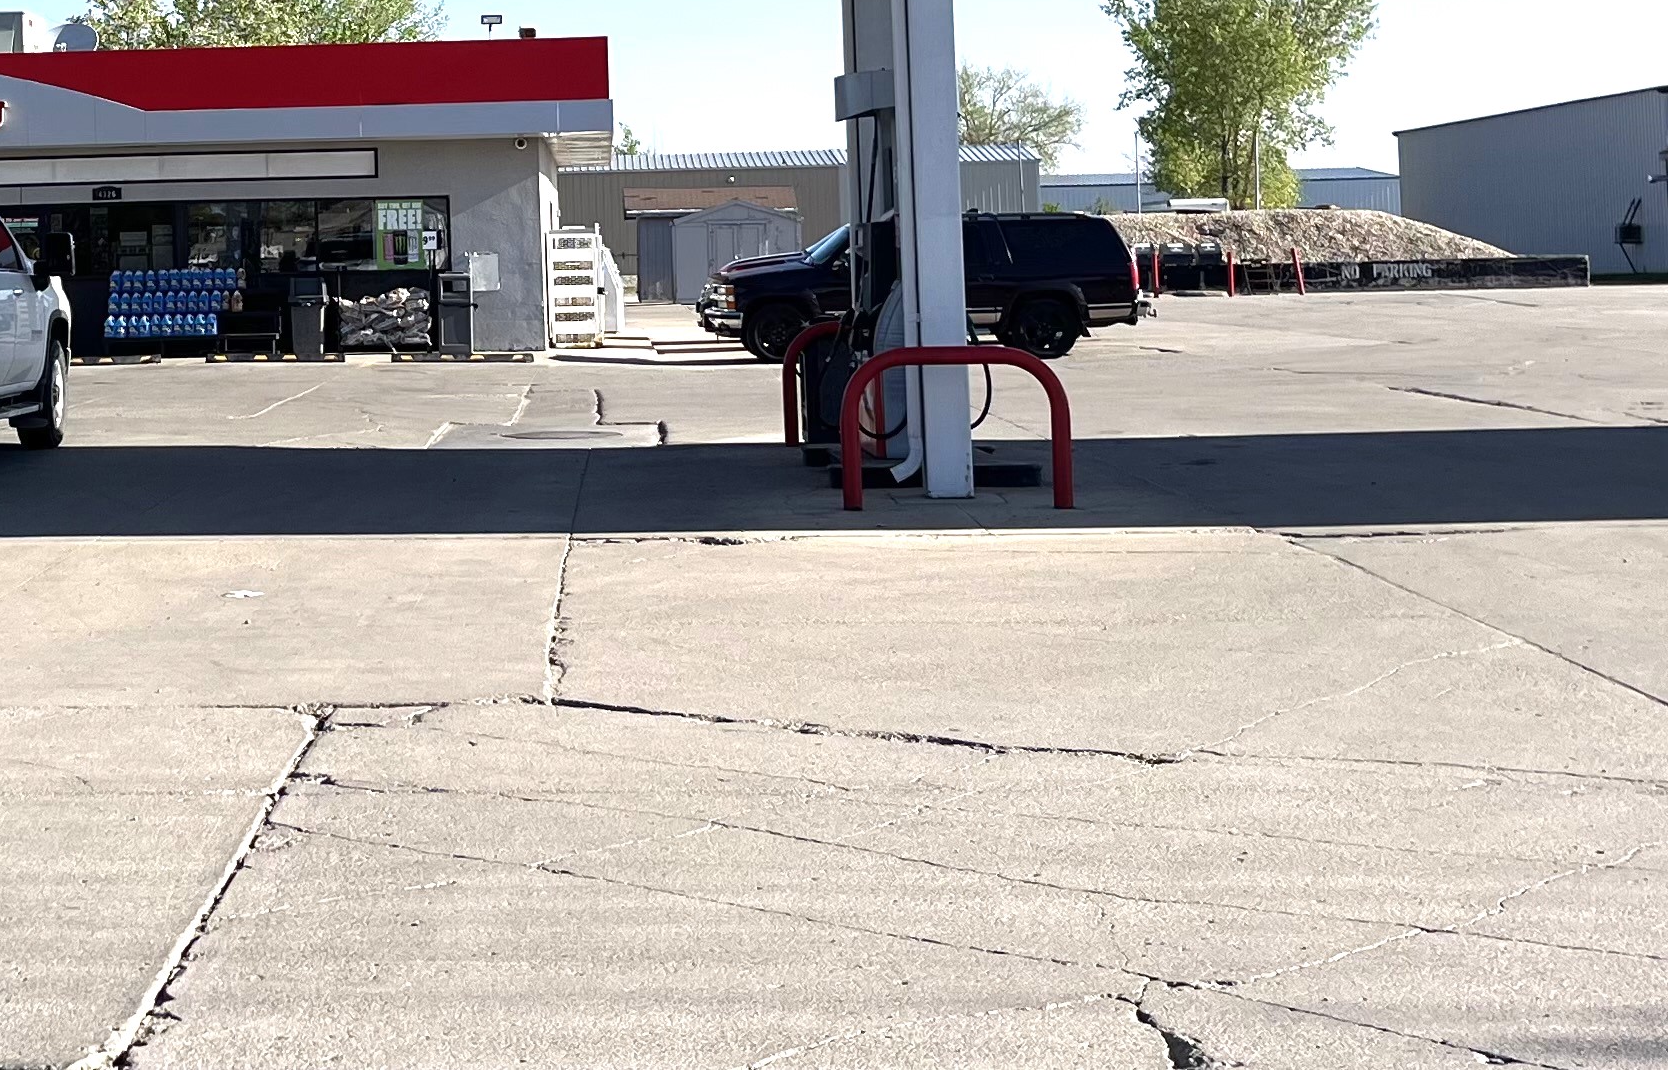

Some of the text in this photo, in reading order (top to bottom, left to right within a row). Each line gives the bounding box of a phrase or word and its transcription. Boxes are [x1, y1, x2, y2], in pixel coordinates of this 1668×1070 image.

[377, 209, 423, 230] FREE!
[1341, 263, 1432, 279] NO PARKING
